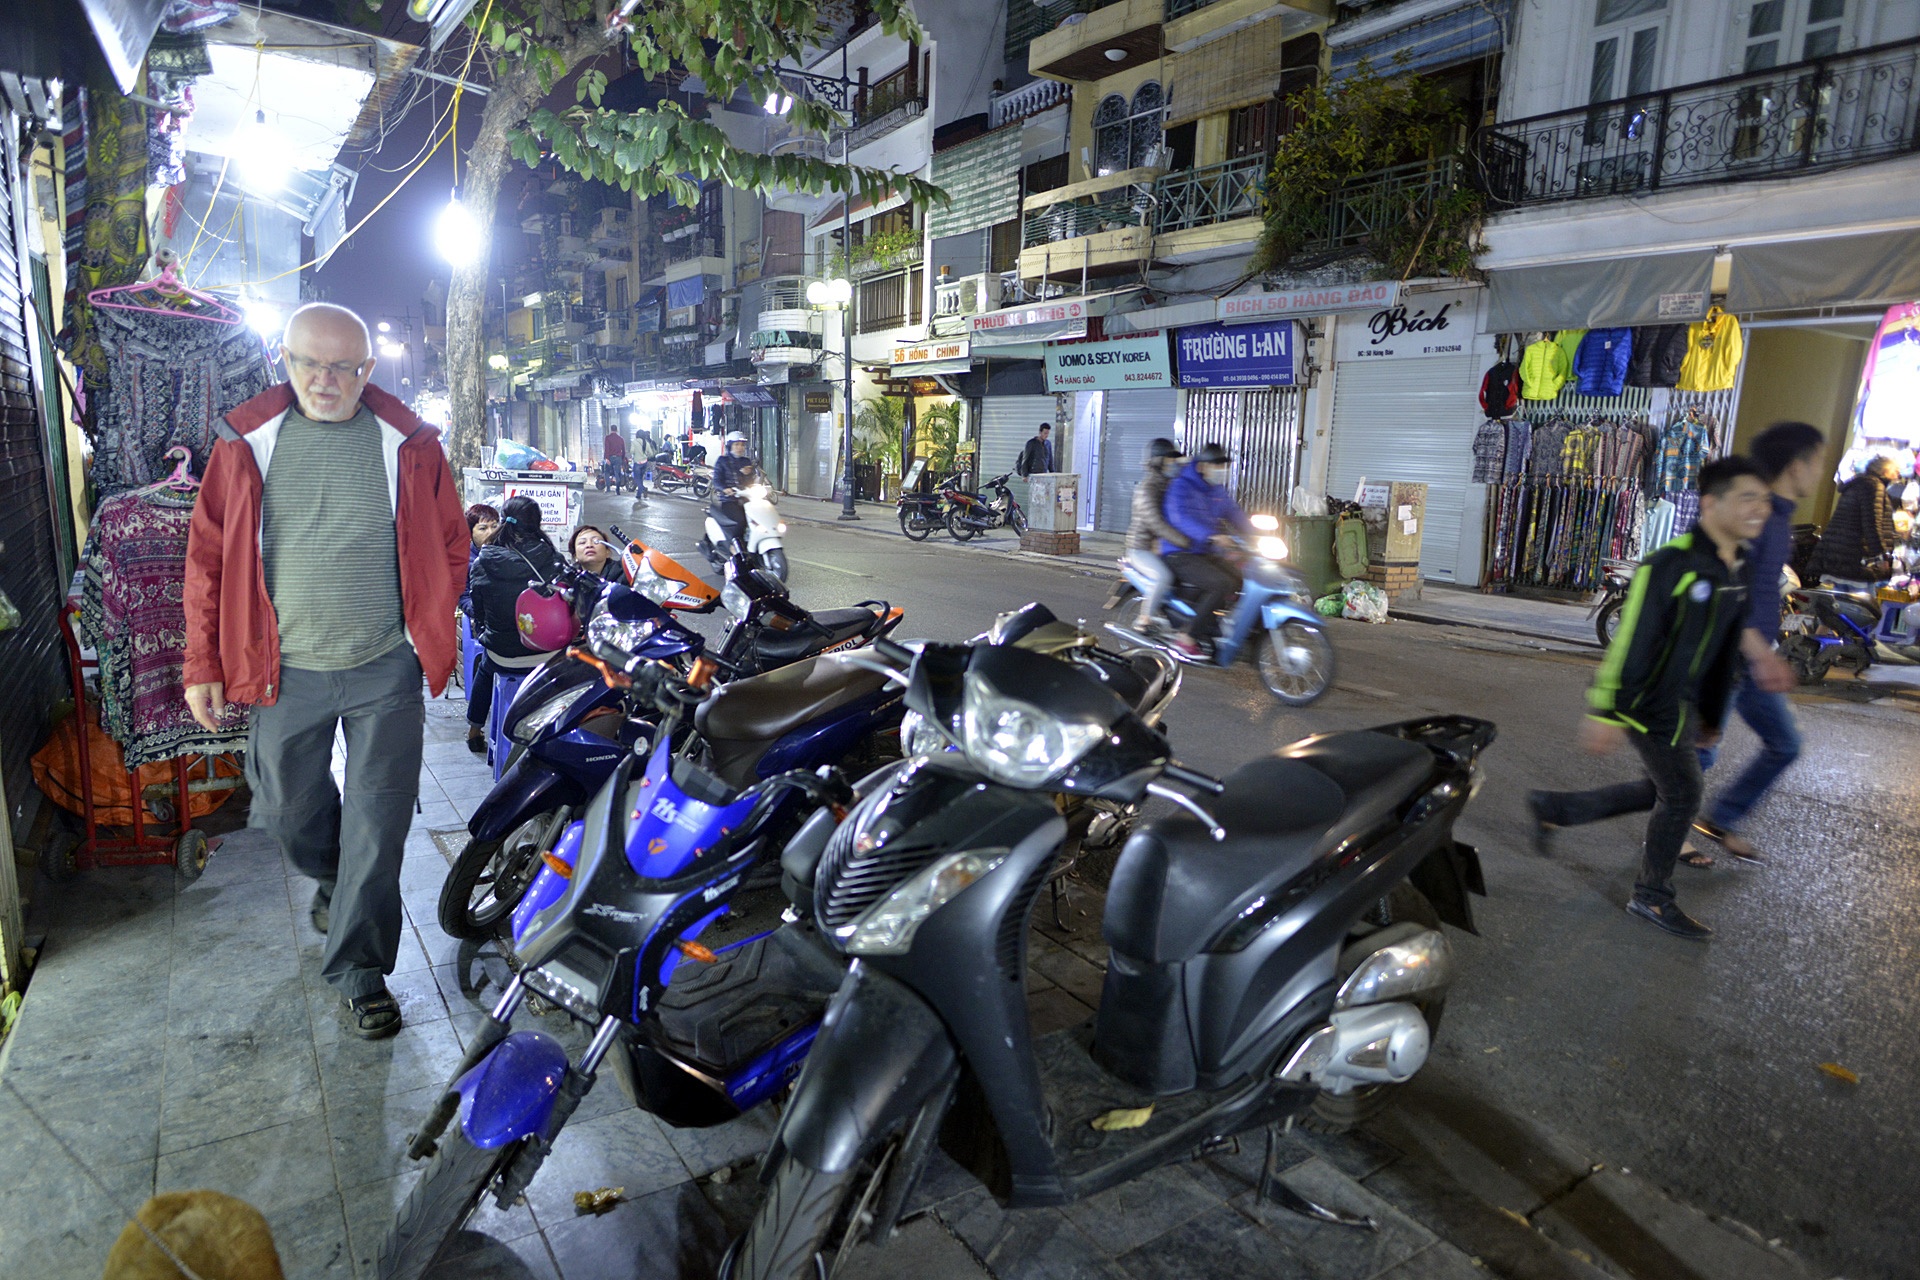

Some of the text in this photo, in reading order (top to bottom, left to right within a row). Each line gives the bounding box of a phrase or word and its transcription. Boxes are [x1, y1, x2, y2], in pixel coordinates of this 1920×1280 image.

[1225, 284, 1388, 314] BÍCH 50 HÀNG ĐÀO
[1367, 303, 1452, 345] Bích
[894, 347, 905, 363] 56
[1182, 331, 1247, 363] TRƯỜNG
[1251, 331, 1286, 357] LAN
[1058, 350, 1151, 368] UOMO & SEXY KOREA
[1054, 374, 1064, 385] 54
[1064, 375, 1082, 385] HÀNG
[1182, 374, 1191, 383] 52
[585, 753, 618, 763] HONDA
